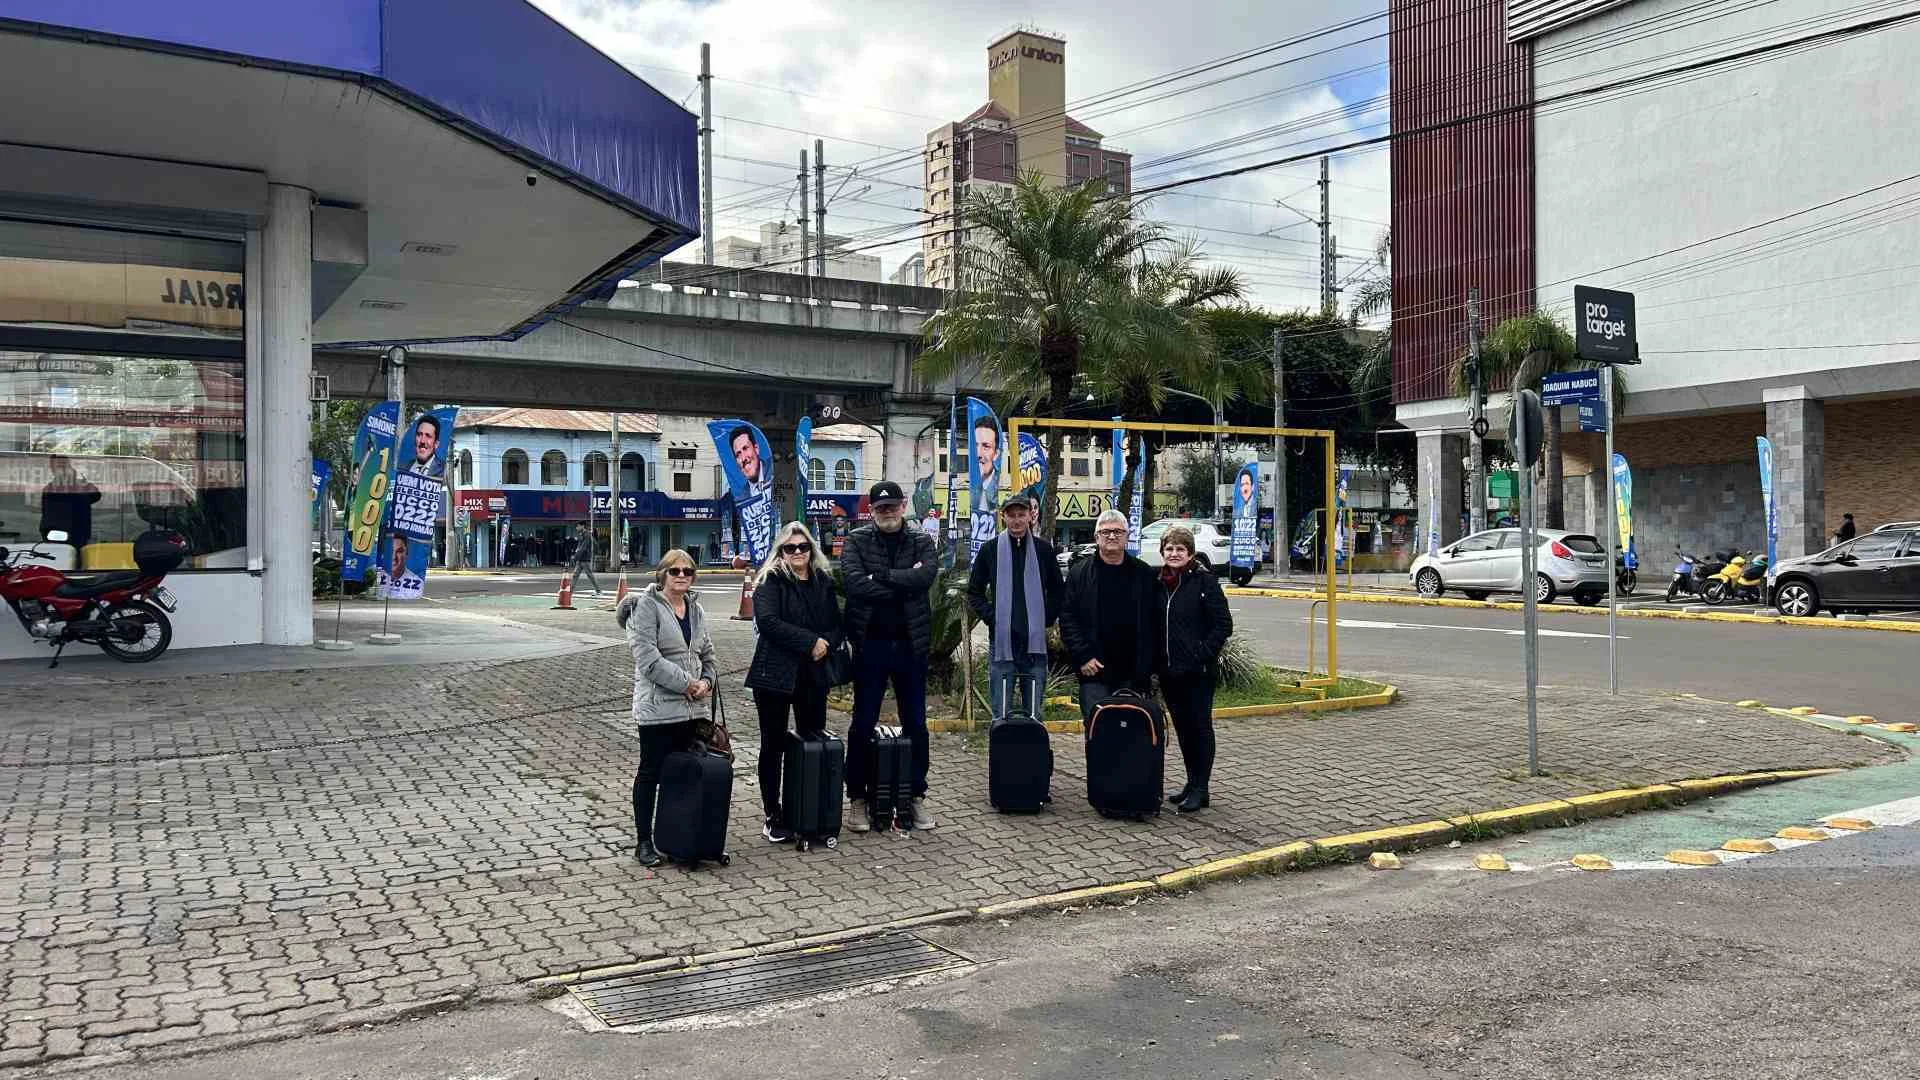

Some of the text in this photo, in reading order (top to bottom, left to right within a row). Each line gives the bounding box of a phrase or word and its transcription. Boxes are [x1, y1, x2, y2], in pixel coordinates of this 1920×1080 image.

[1021, 46, 1064, 64] union
[1585, 302, 1608, 319] pro
[1586, 320, 1626, 340] target
[1542, 378, 1597, 392] JOAQUIM NABUCO
[366, 415, 396, 436] SIMONE
[464, 498, 483, 506] MIX
